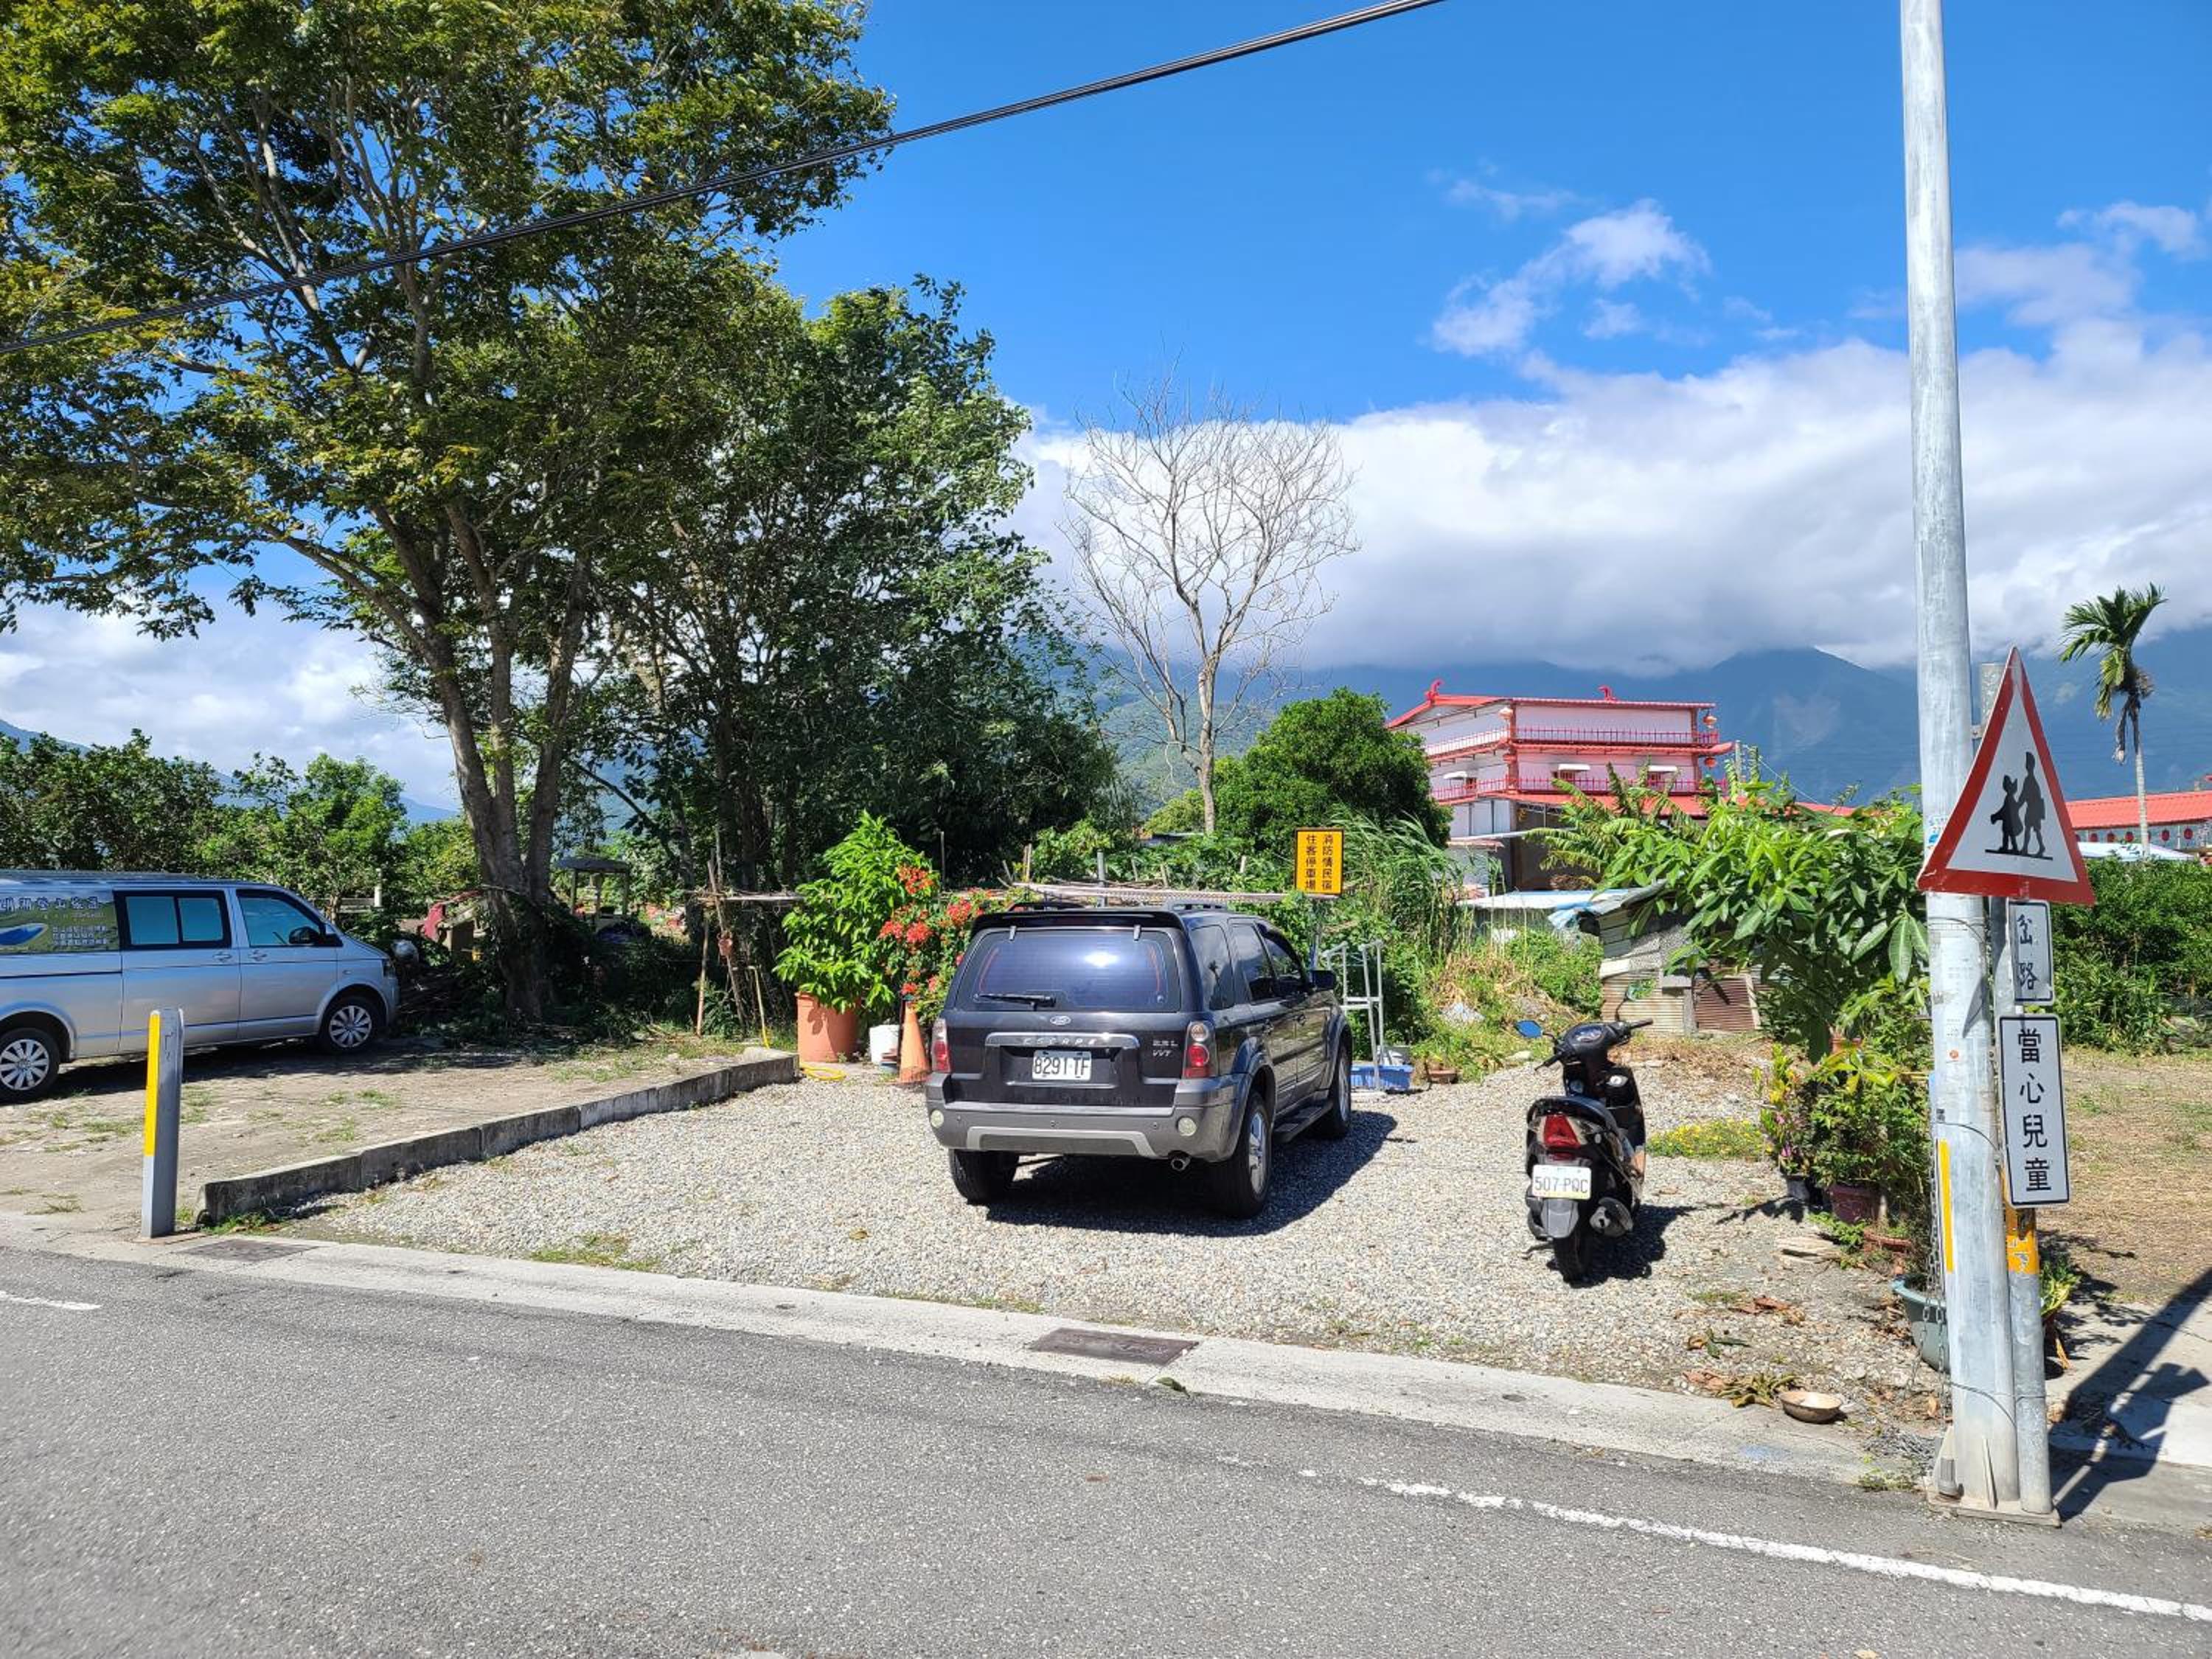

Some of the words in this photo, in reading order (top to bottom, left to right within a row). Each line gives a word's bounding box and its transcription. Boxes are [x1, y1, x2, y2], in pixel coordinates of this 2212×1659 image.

[2017, 914, 2037, 990] 岔路
[2017, 1028, 2052, 1192] 當心兒童
